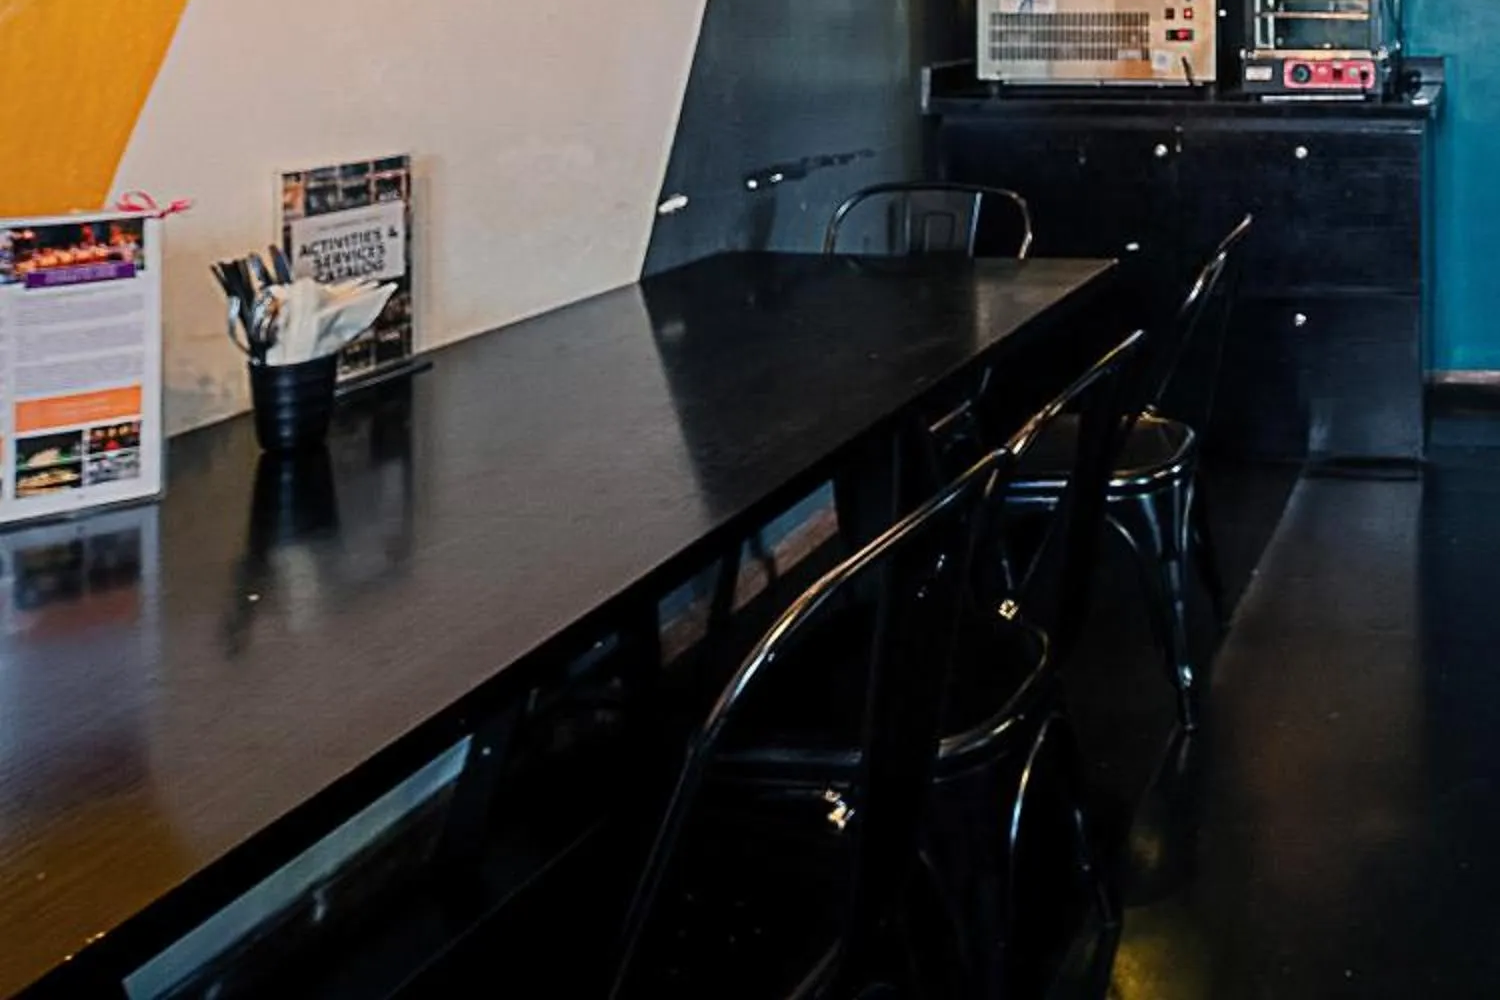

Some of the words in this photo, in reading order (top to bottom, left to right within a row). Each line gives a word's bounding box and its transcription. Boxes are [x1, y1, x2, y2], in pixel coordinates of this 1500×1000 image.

[300, 228, 383, 257] ACTIVITIES
[387, 226, 398, 238] &
[313, 243, 385, 270] SERVICES
[314, 259, 385, 284] CATALOG
